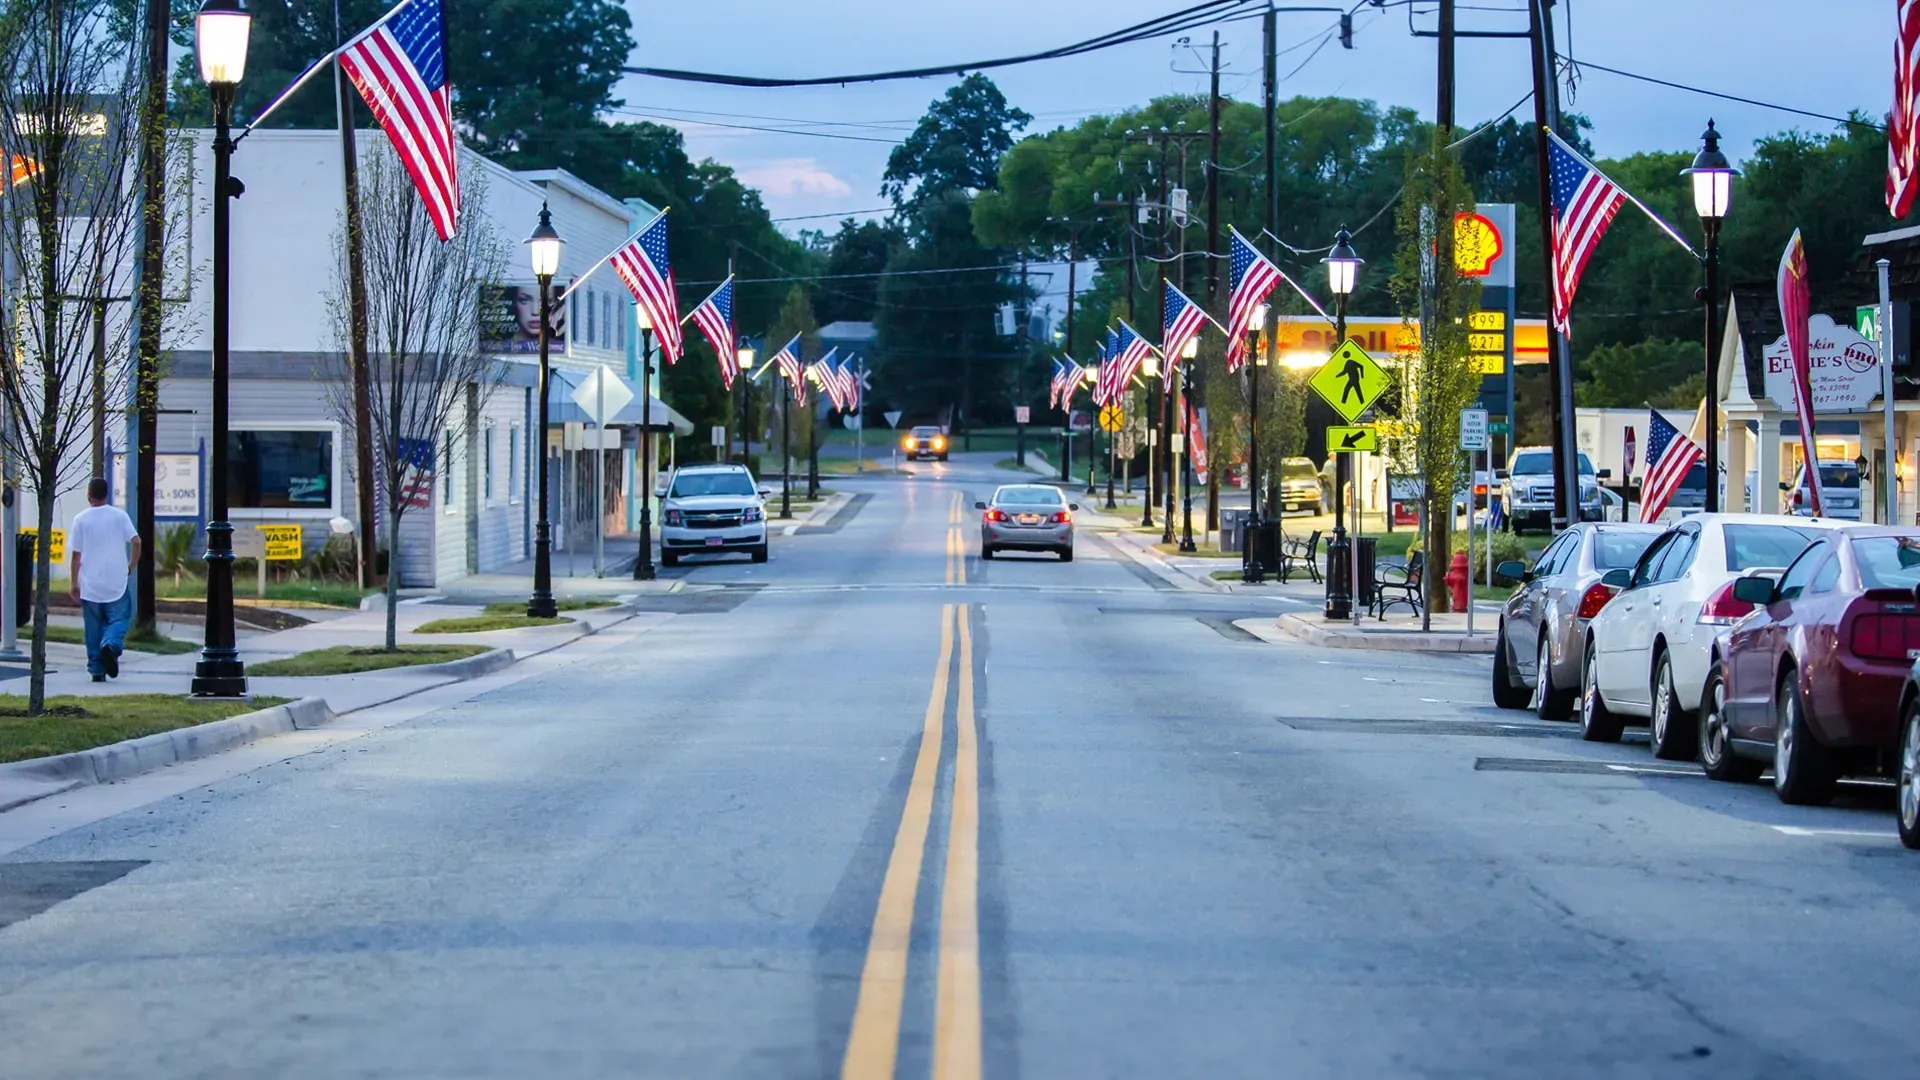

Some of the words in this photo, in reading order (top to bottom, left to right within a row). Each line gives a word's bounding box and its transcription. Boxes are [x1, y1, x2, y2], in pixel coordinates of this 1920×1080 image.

[1777, 338, 1834, 354] Sokin
[1768, 355, 1842, 373] EDIE'S
[1843, 346, 1878, 367] BBQ
[172, 489, 196, 499] SONS
